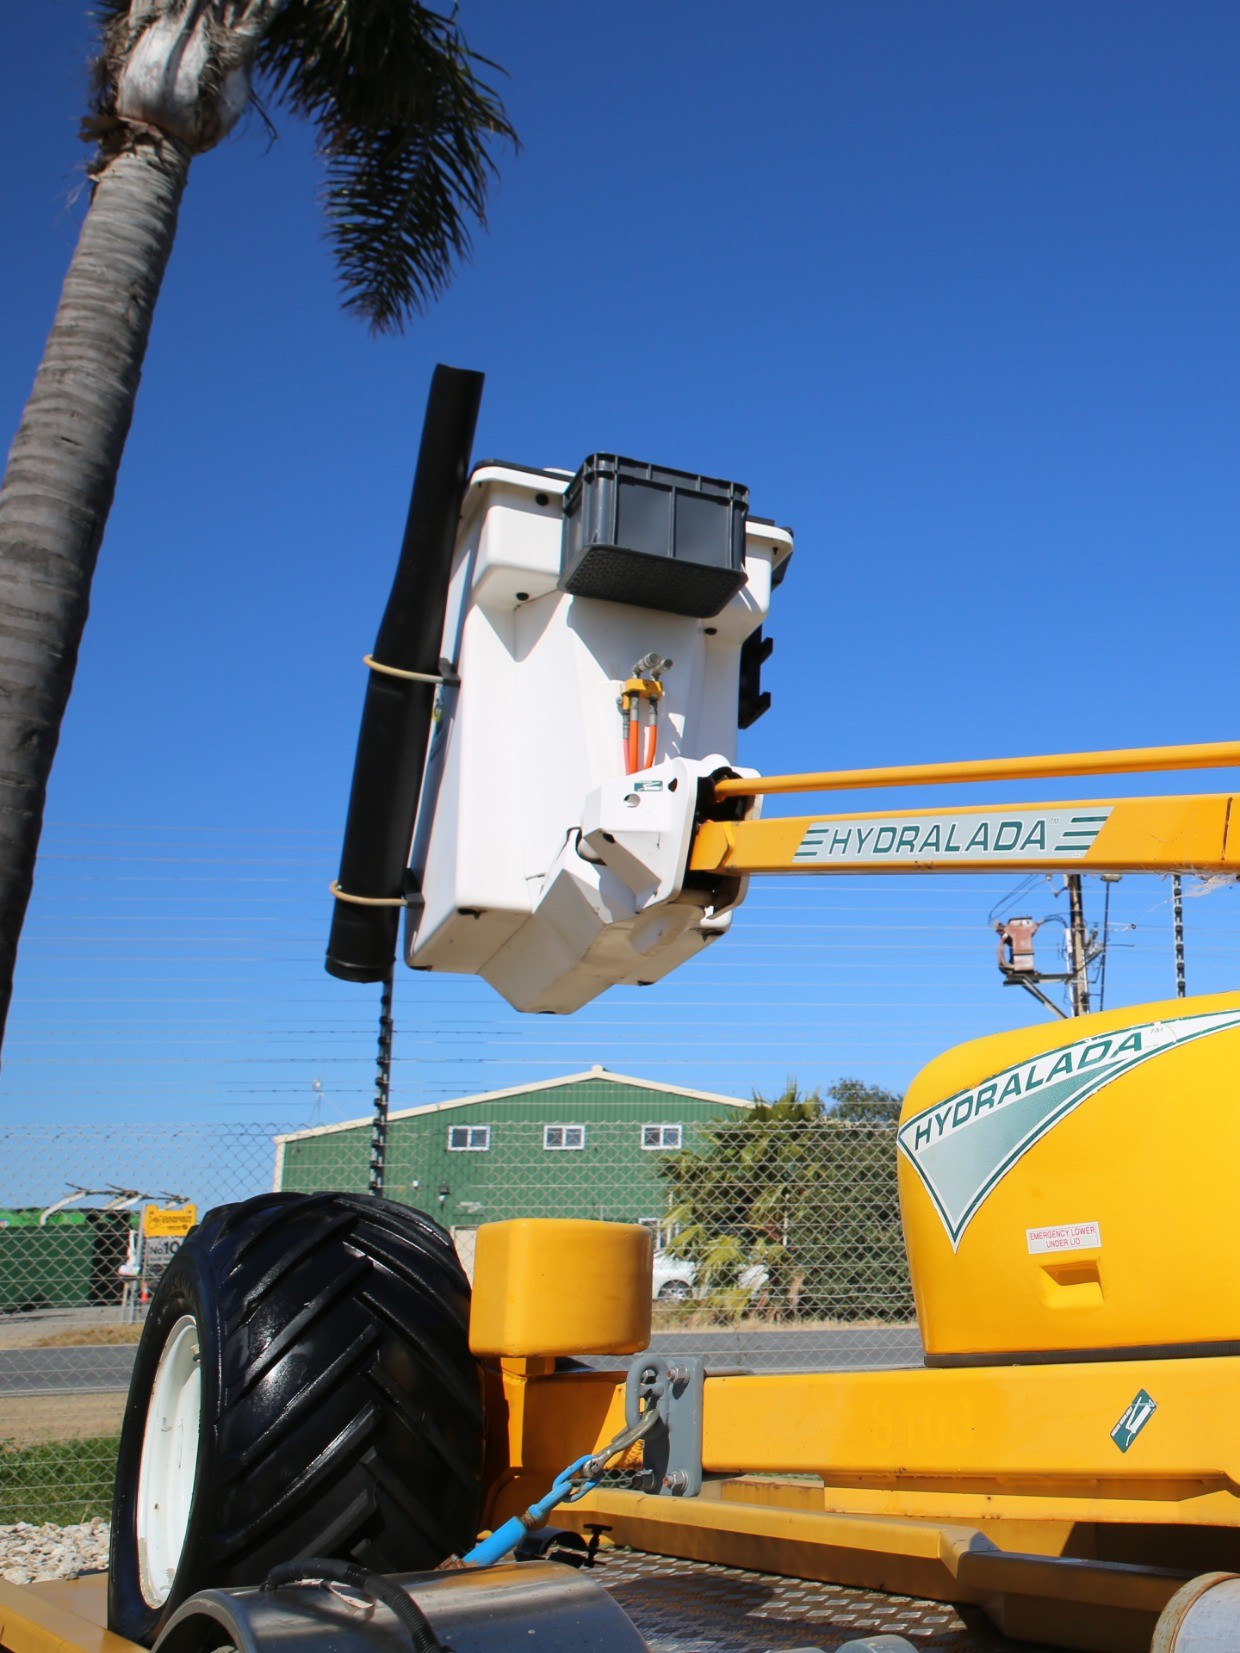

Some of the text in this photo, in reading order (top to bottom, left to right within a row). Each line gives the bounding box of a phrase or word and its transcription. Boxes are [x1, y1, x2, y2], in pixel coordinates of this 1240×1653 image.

[828, 820, 1046, 855] HYDRALADA
[914, 1031, 1144, 1151] HYDRALADA
[1030, 1226, 1096, 1240] EMERGENCY LOWER
[1046, 1237, 1081, 1248] UNDER LID
